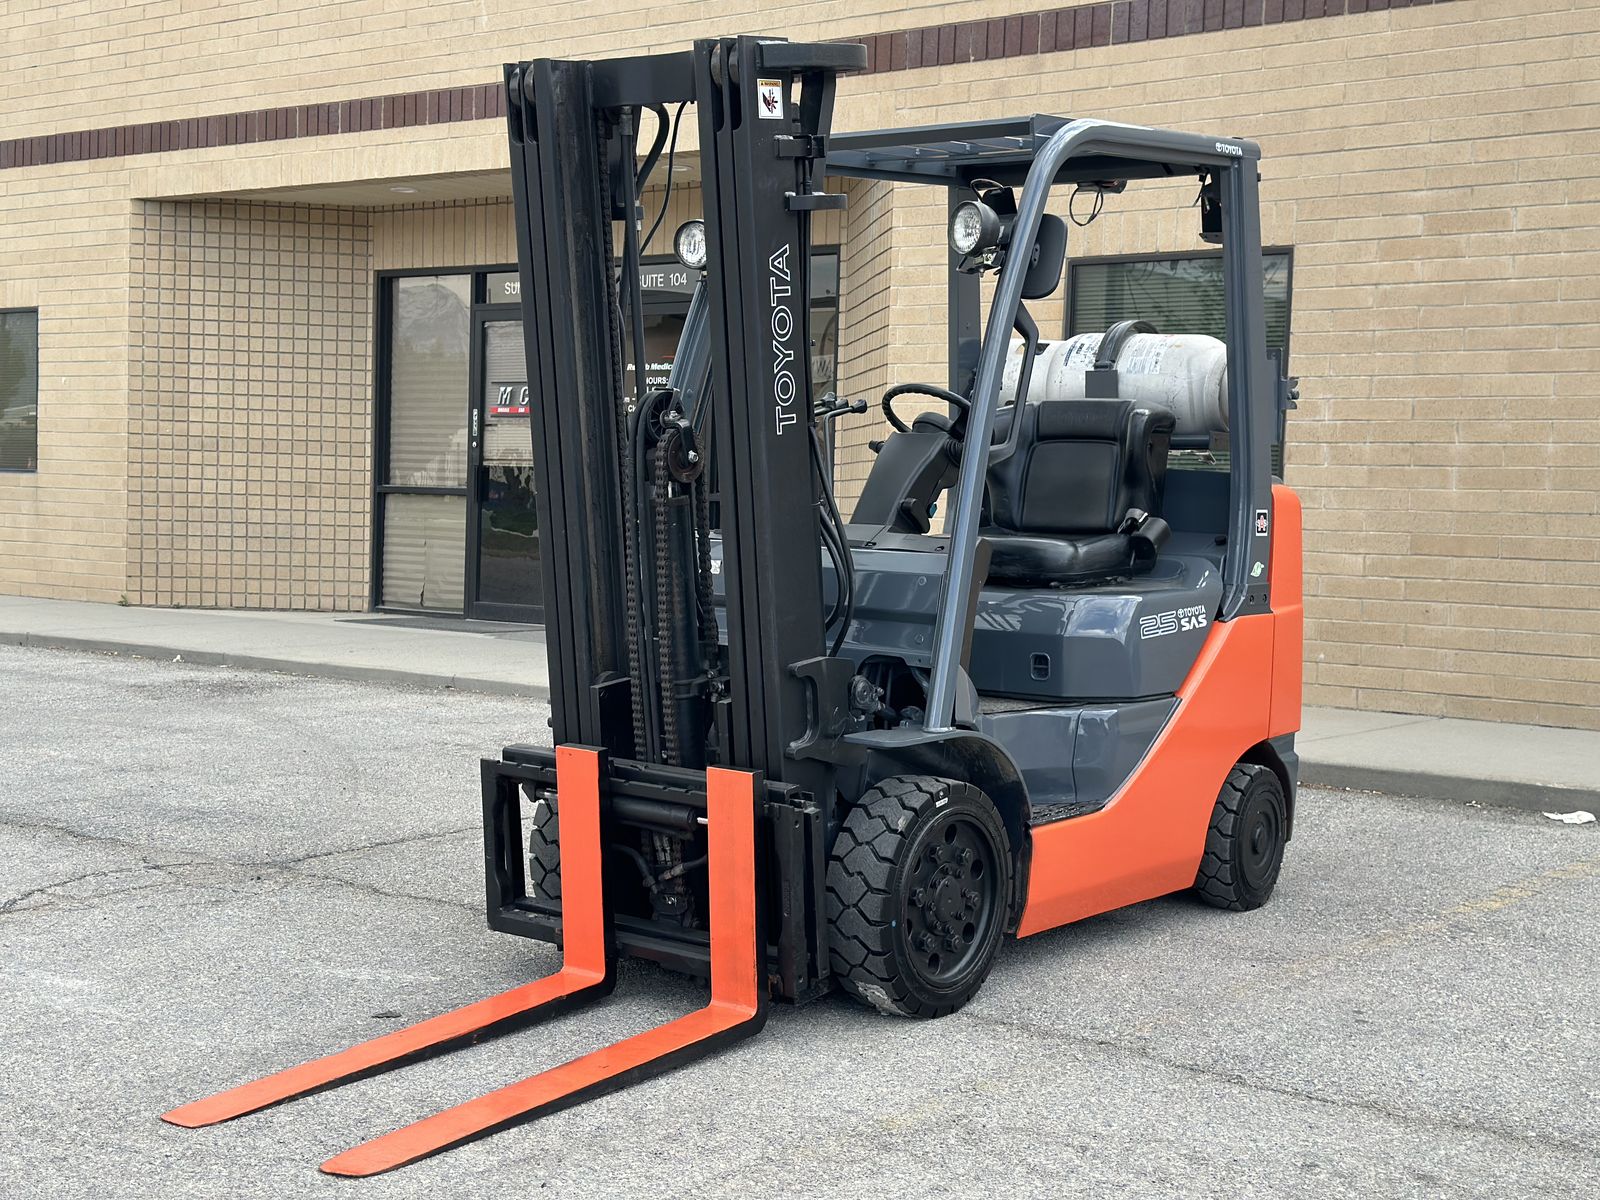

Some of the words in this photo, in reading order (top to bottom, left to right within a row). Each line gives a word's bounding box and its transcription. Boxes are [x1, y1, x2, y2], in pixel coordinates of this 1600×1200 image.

[1222, 143, 1243, 156] TOYOTA
[640, 273, 664, 287] UITE
[669, 272, 687, 286] 104
[769, 244, 797, 435] TOYOTA
[1184, 605, 1206, 617] TOYOTA
[1139, 610, 1179, 640] 25
[1180, 614, 1208, 632] SAS
